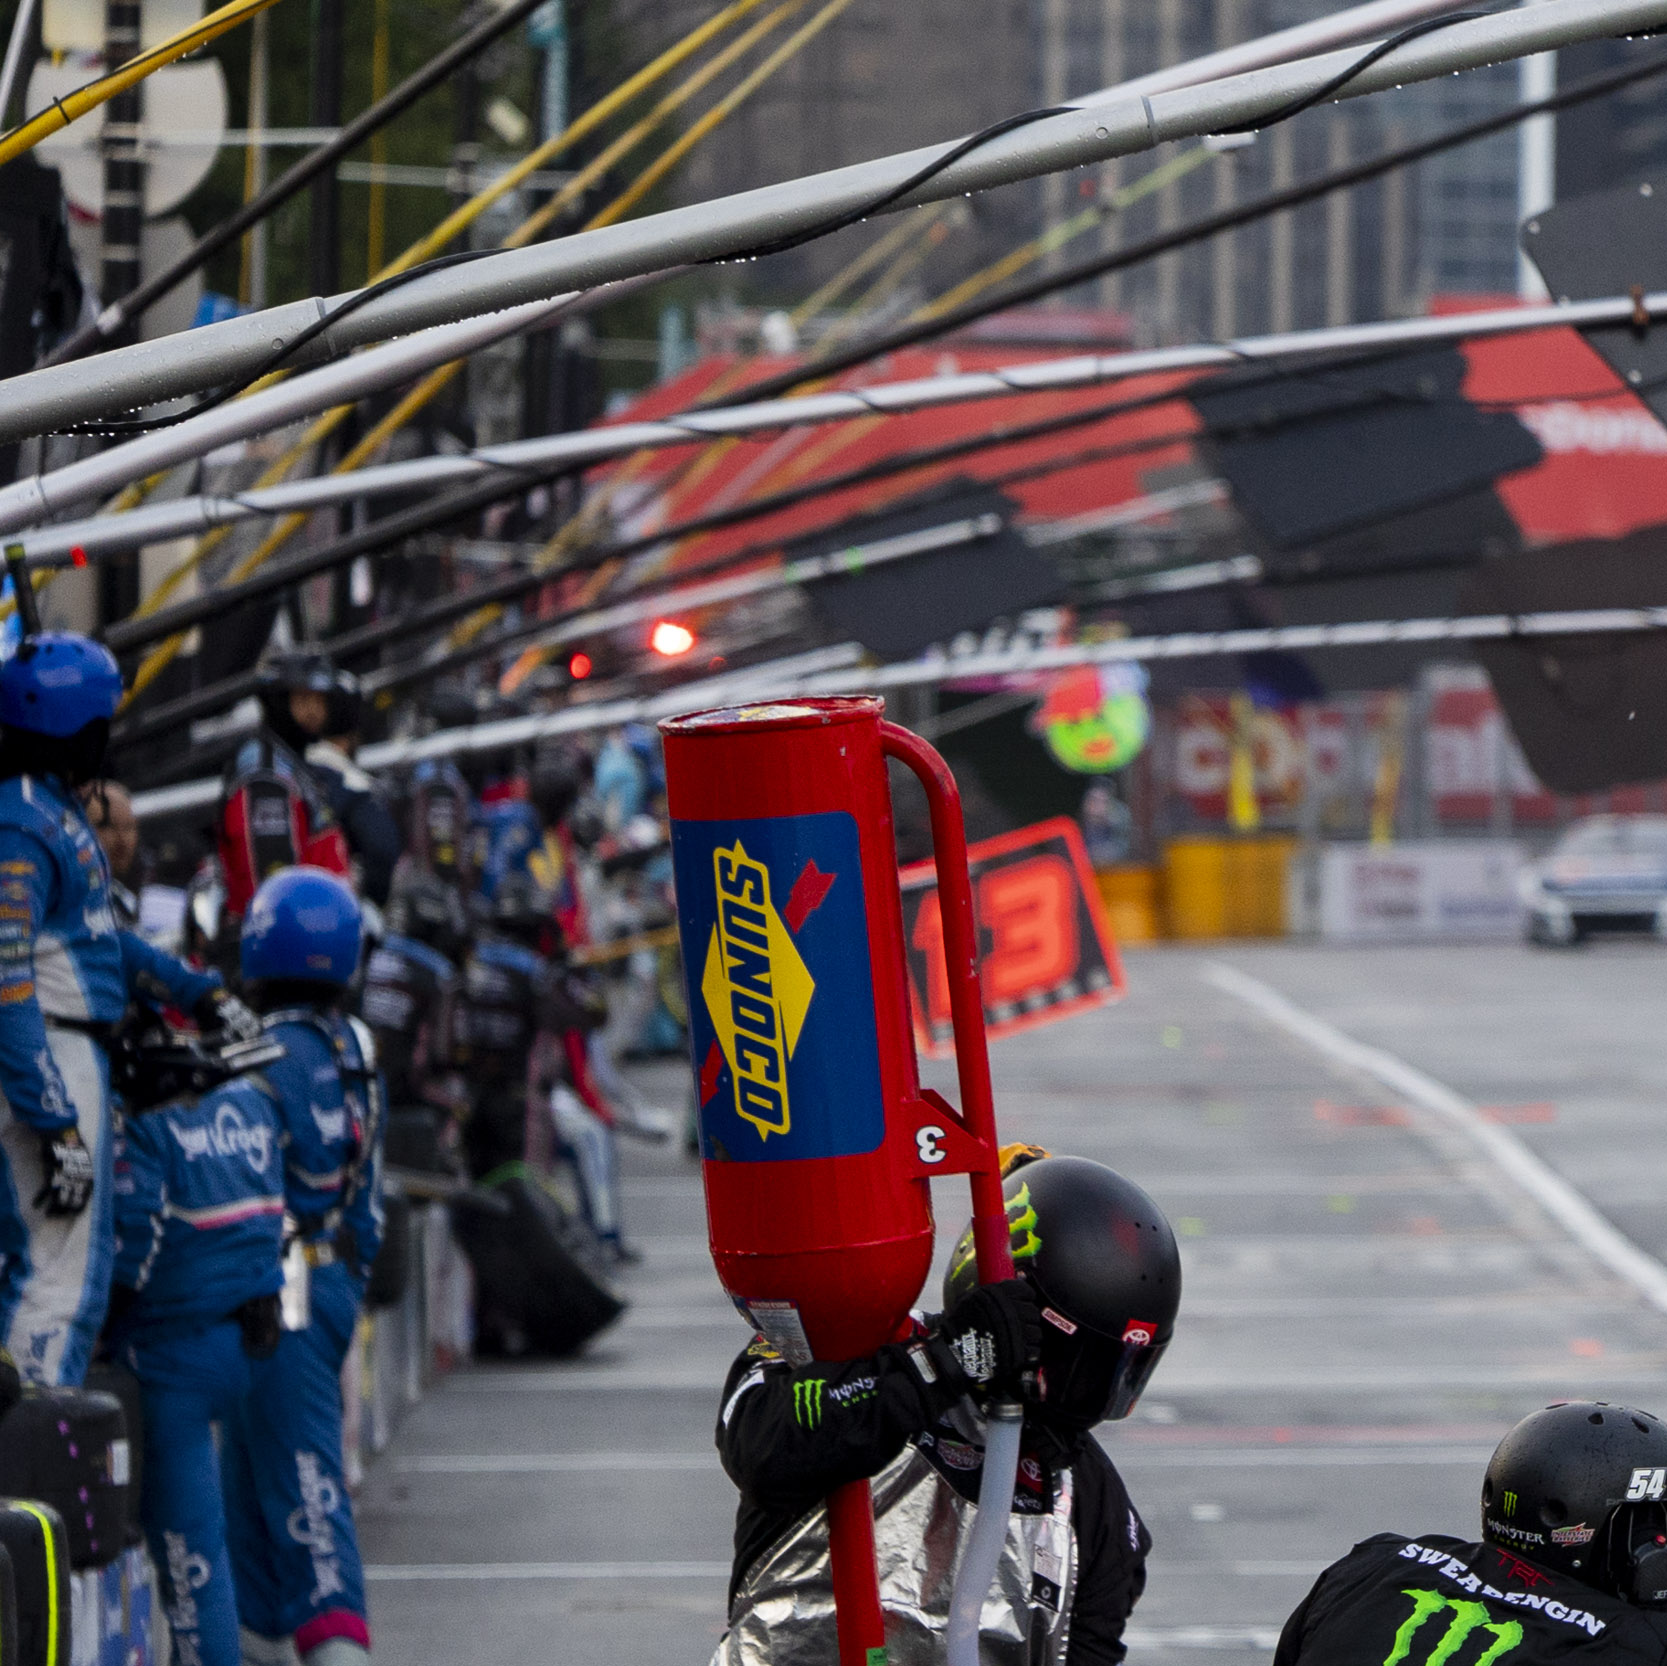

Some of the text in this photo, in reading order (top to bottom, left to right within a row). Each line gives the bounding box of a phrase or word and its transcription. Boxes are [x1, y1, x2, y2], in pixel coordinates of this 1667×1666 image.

[717, 854, 785, 1128] SUNOCO
[828, 1377, 879, 1401] MONS
[1626, 1467, 1667, 1500] 54
[1487, 1518, 1545, 1546] MONSTER
